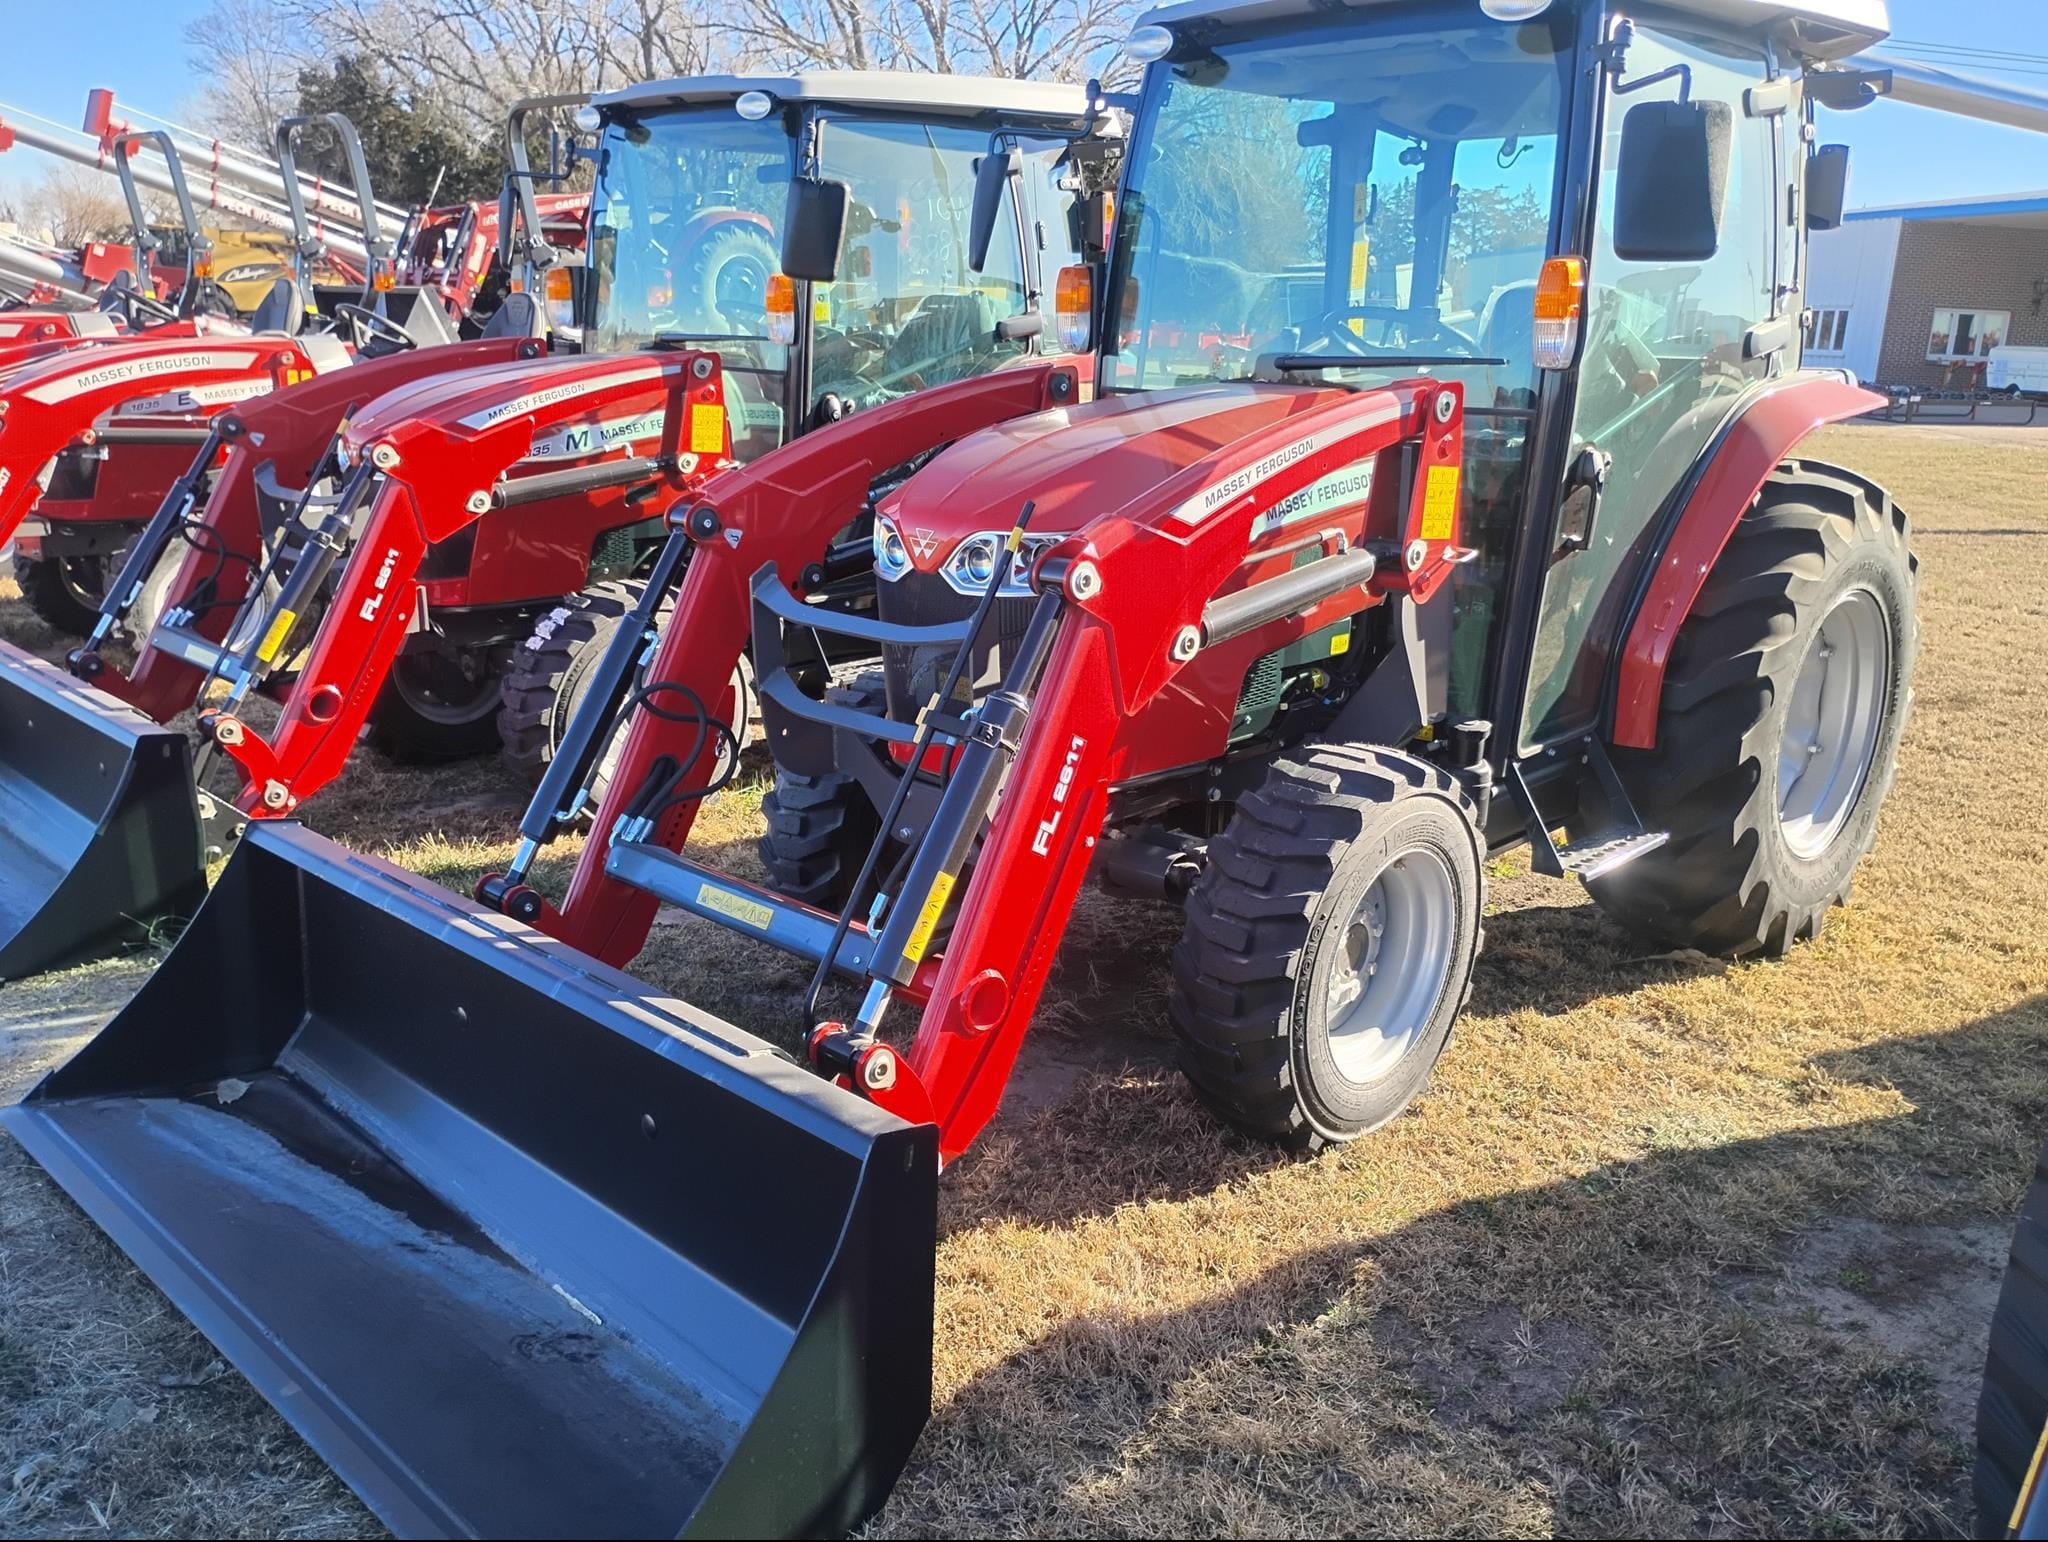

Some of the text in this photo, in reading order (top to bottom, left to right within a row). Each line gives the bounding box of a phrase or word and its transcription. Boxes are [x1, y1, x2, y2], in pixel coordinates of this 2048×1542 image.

[77, 355, 212, 388] MASSEY FERGUSON
[131, 391, 191, 412] 1835 E
[204, 387, 246, 401] MASSEY
[488, 383, 586, 421] MASSEY FERGUSON
[565, 430, 589, 452] M
[600, 422, 647, 441] MASSEY
[1204, 438, 1314, 508] MASSEY FERGUSON
[1265, 490, 1315, 522] MASSEY
[359, 593, 384, 622] FL
[1031, 735, 1085, 857] FL 2611
